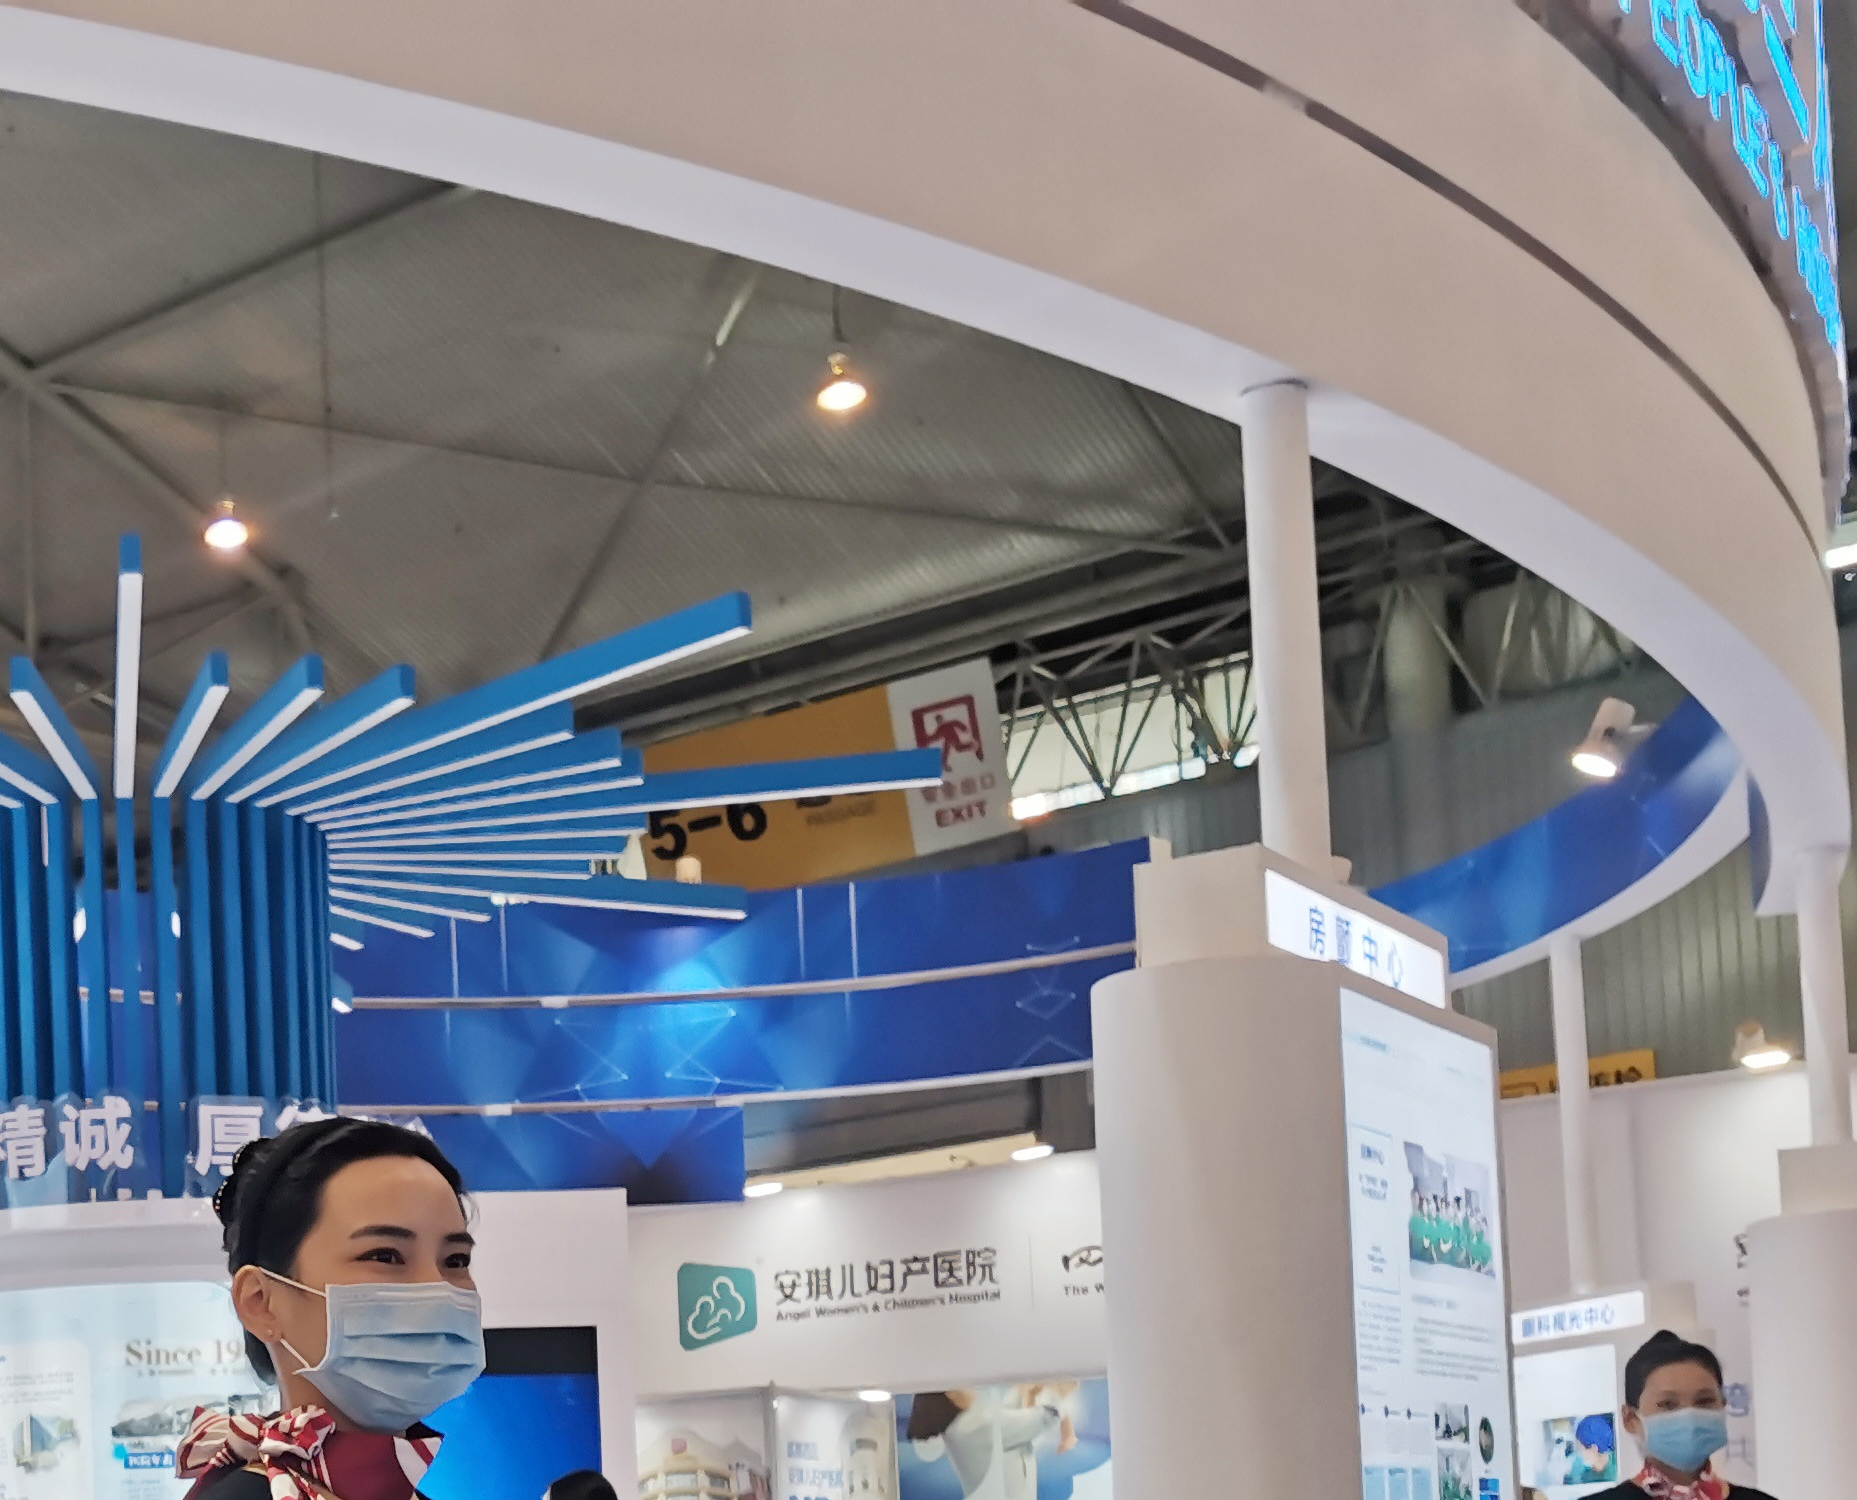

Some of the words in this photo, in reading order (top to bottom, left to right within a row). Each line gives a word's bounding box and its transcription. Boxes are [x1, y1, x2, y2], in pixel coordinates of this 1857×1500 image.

[935, 801, 987, 828] EXIT
[773, 1246, 1000, 1305] 安琪儿妇产医院
[125, 1339, 202, 1367] Since
